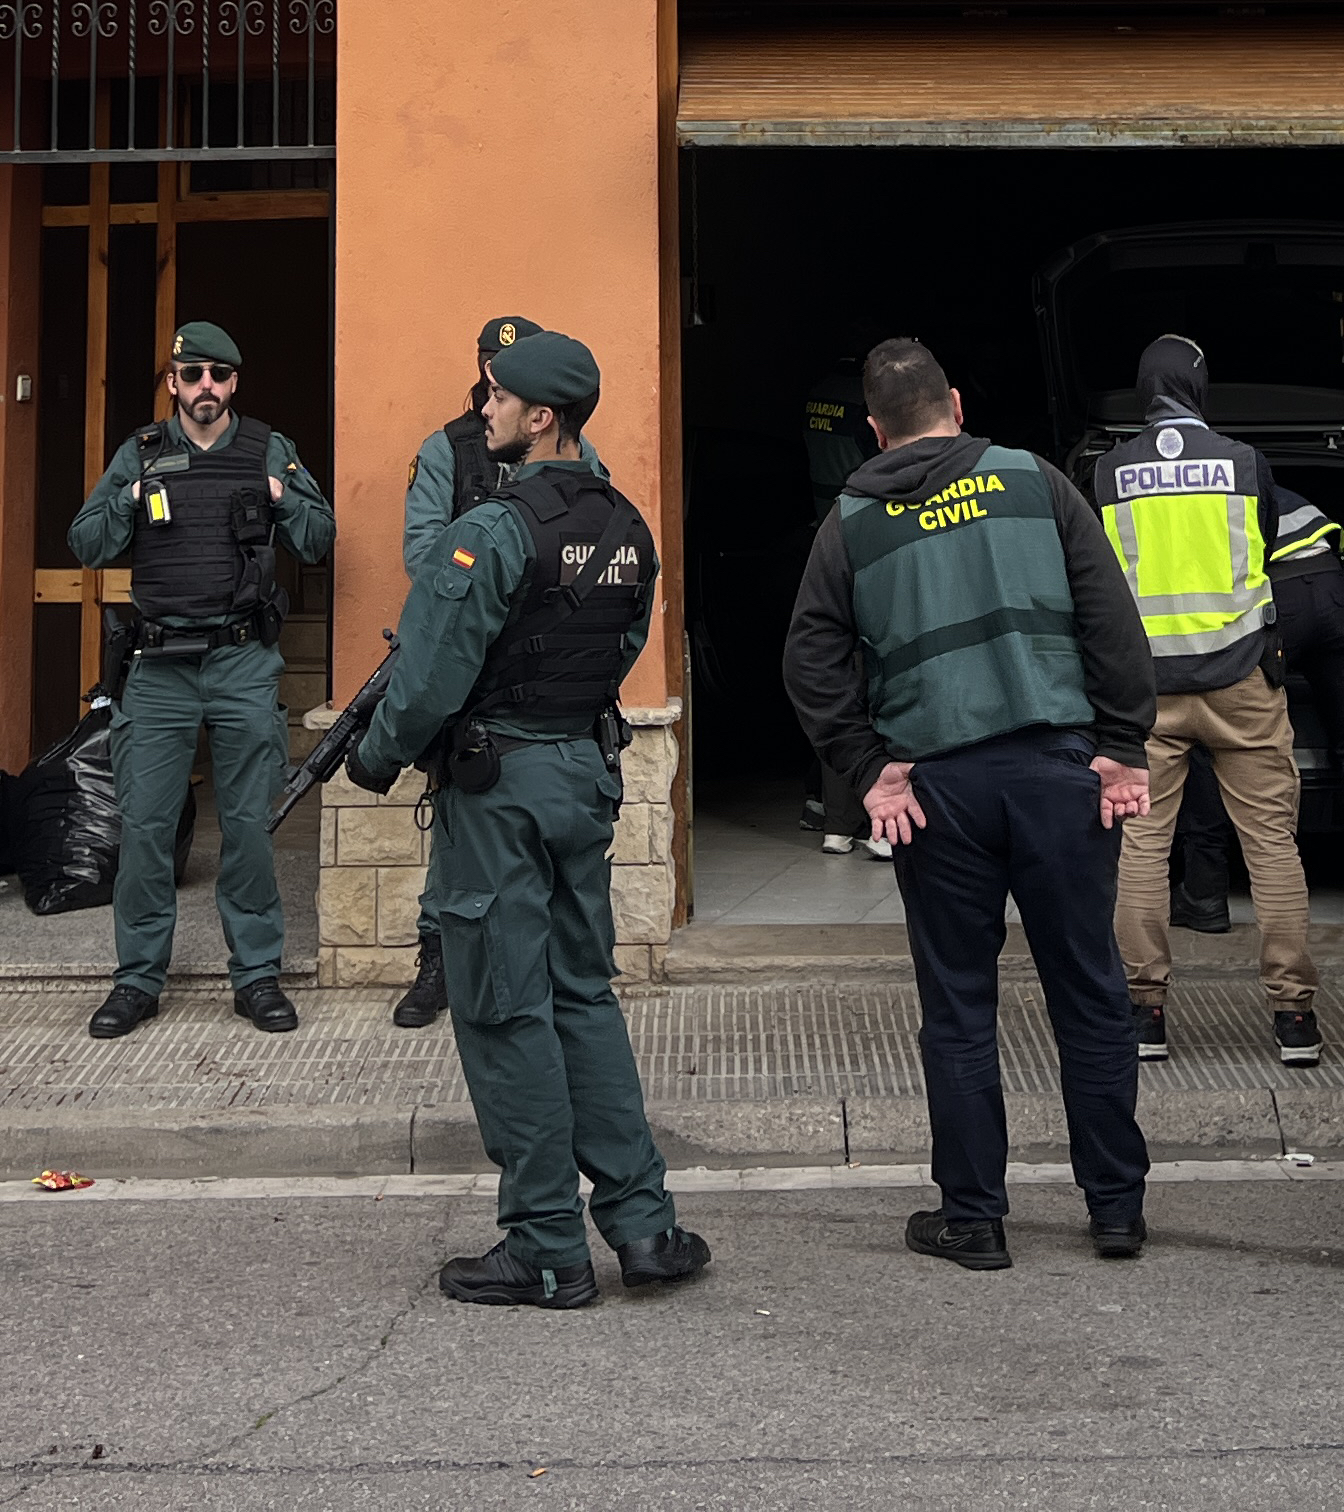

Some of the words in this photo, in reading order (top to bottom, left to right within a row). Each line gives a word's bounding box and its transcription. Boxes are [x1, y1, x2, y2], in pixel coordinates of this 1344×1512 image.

[806, 402, 845, 418] GUARDIA
[809, 417, 833, 432] CIVIL
[1120, 464, 1230, 493] POLICIA
[918, 499, 988, 531] CIVIL
